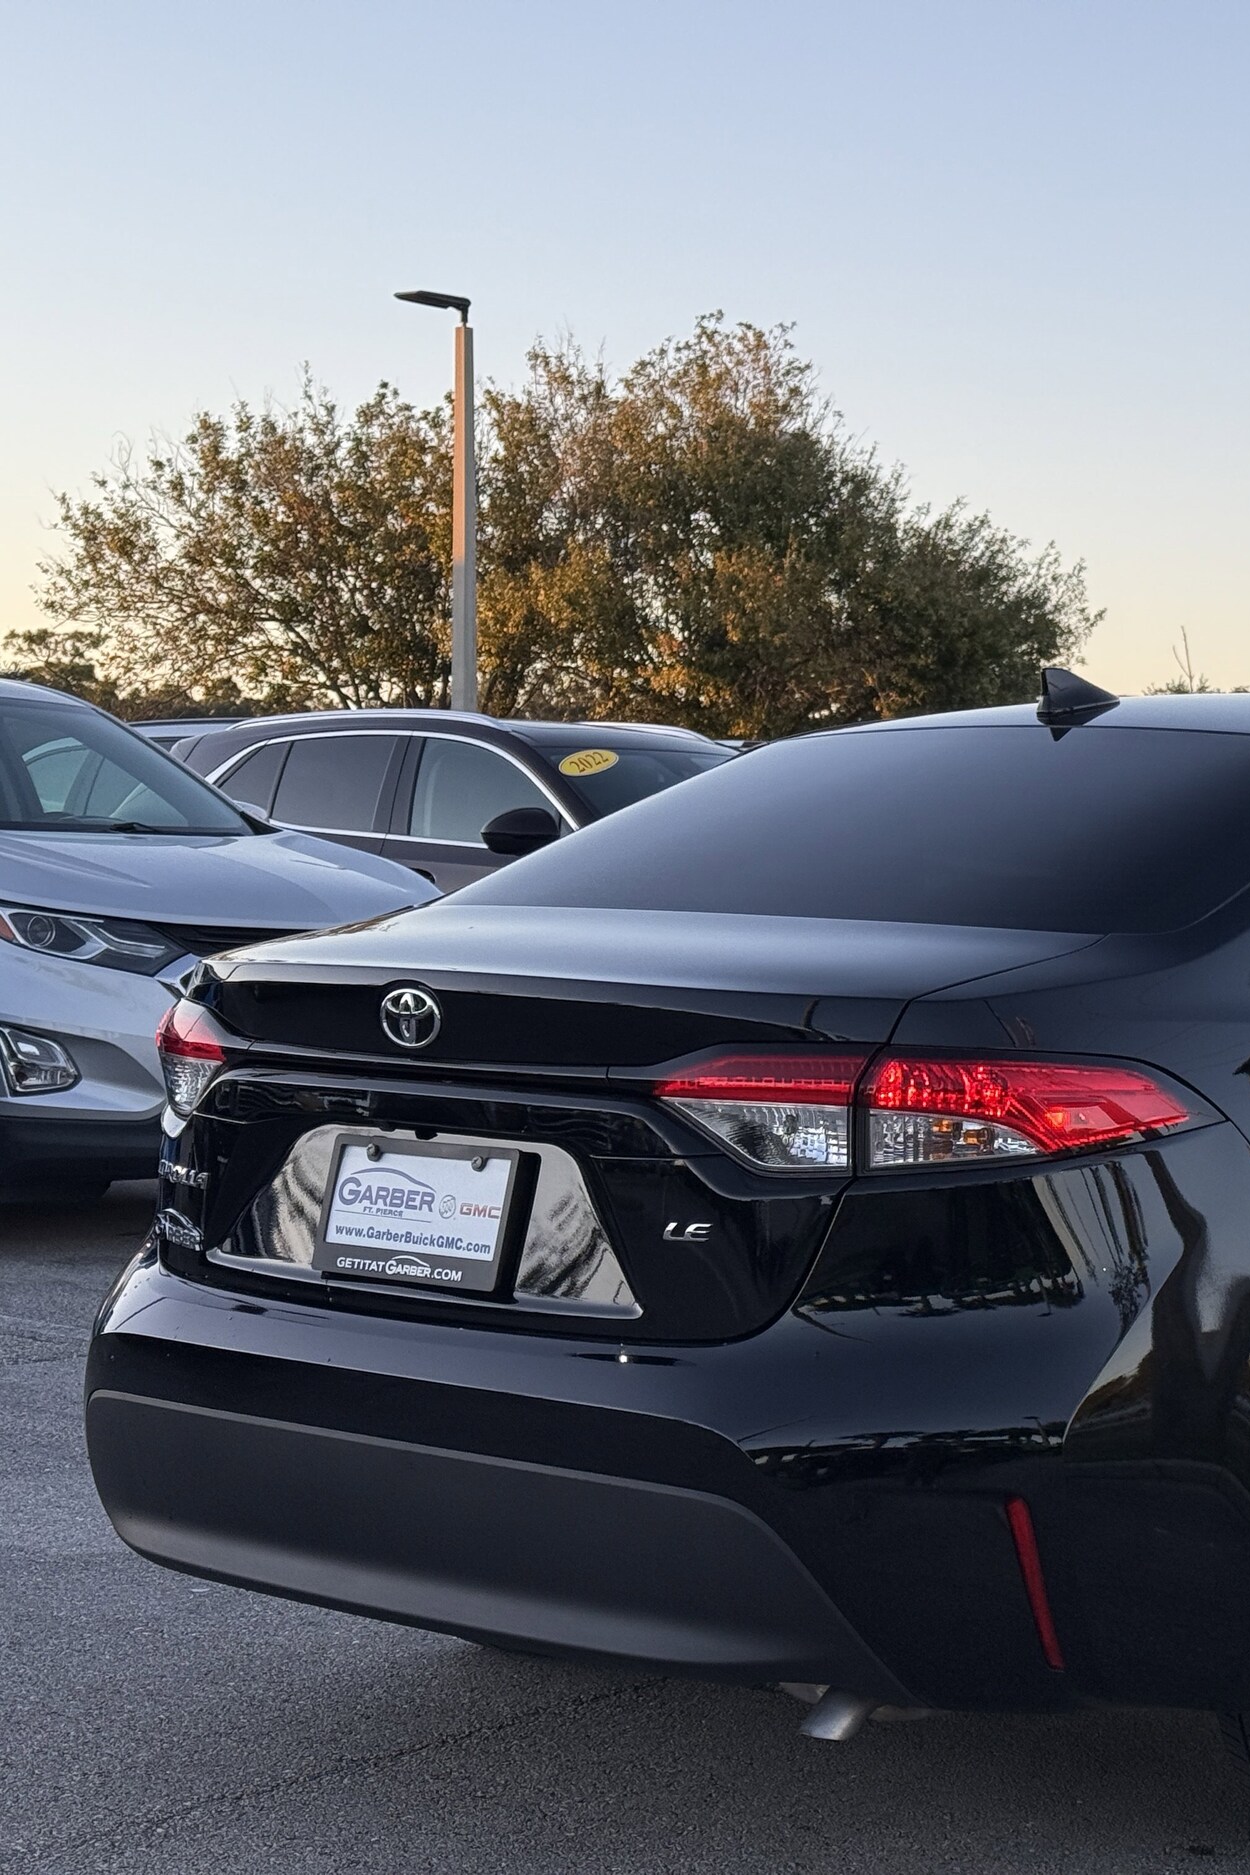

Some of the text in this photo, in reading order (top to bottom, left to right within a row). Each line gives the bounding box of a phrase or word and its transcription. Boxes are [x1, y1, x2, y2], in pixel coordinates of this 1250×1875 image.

[569, 751, 609, 774] 2022
[338, 1176, 436, 1213] GARBER
[375, 1207, 404, 1218] PIERCE
[459, 1202, 502, 1220] GMC
[335, 1224, 491, 1255] www.GarberBuickGMC.com
[662, 1222, 713, 1242] LE
